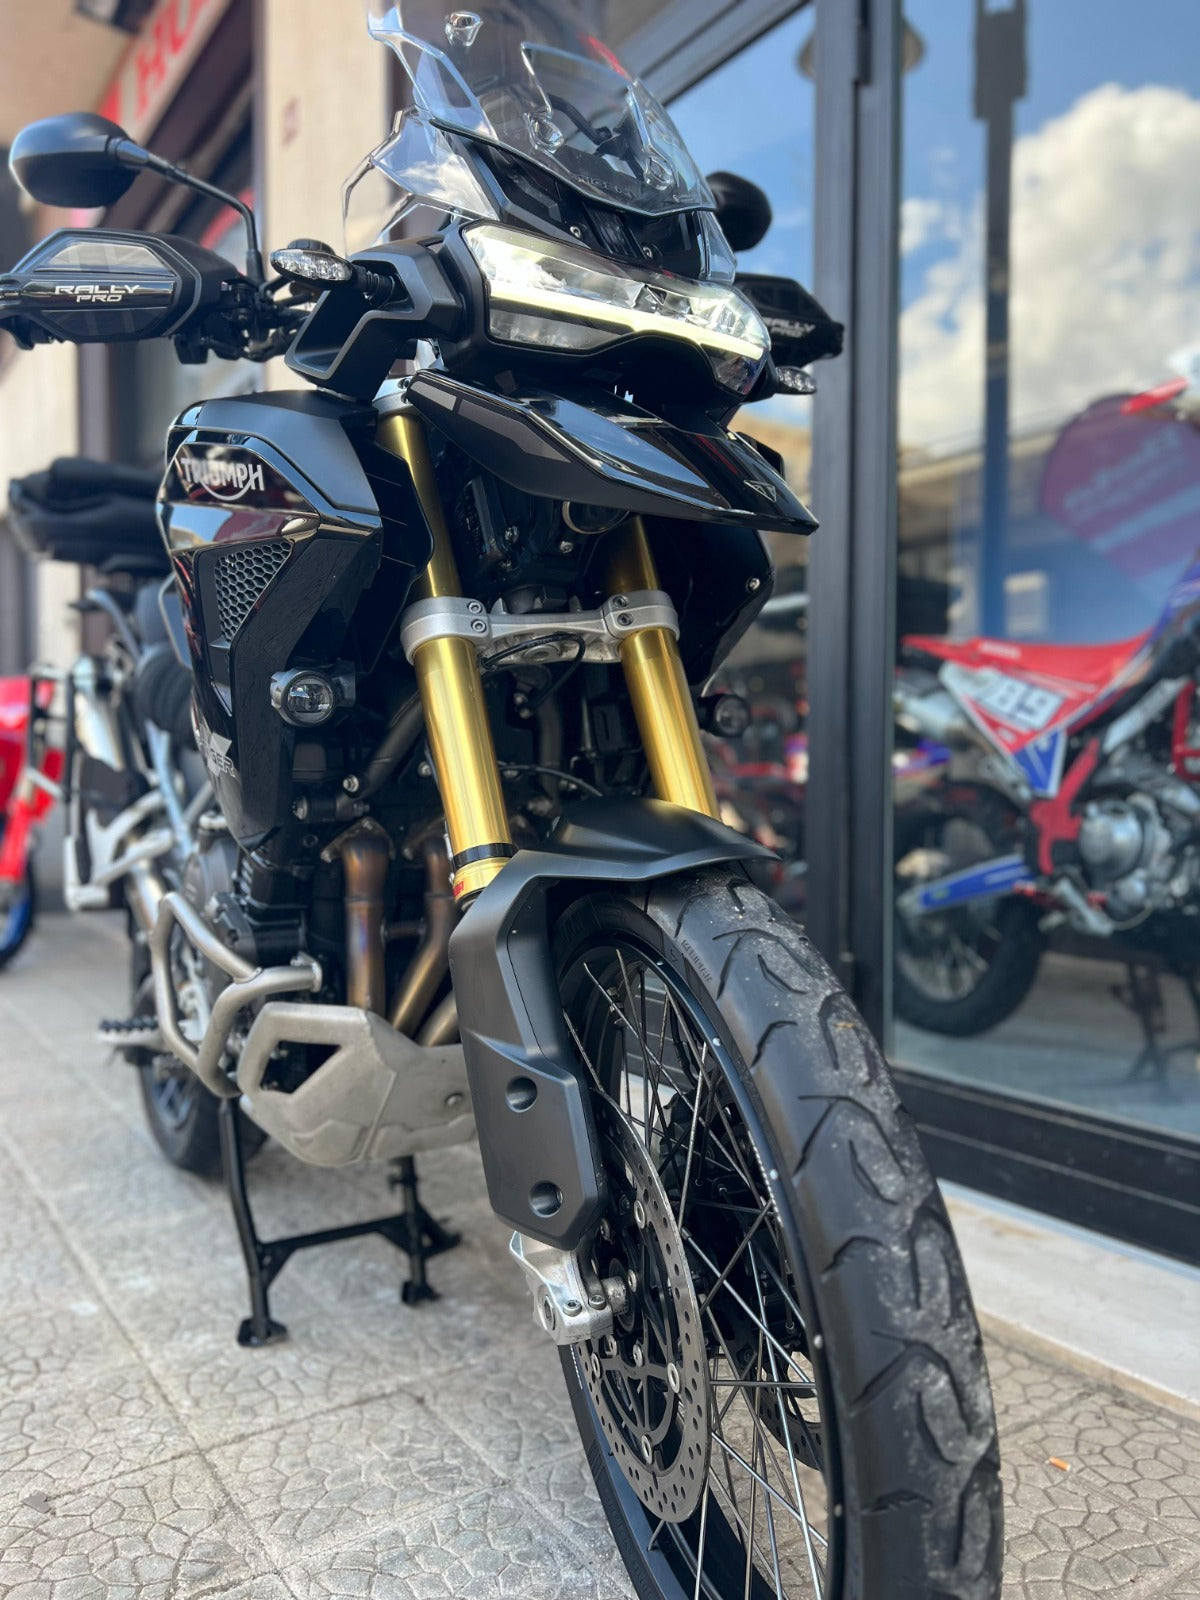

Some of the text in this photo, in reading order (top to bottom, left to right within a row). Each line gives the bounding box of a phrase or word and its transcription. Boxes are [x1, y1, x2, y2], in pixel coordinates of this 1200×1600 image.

[54, 285, 140, 295] RALLY
[76, 294, 122, 303] PRO
[180, 457, 265, 499] TRIUMPH
